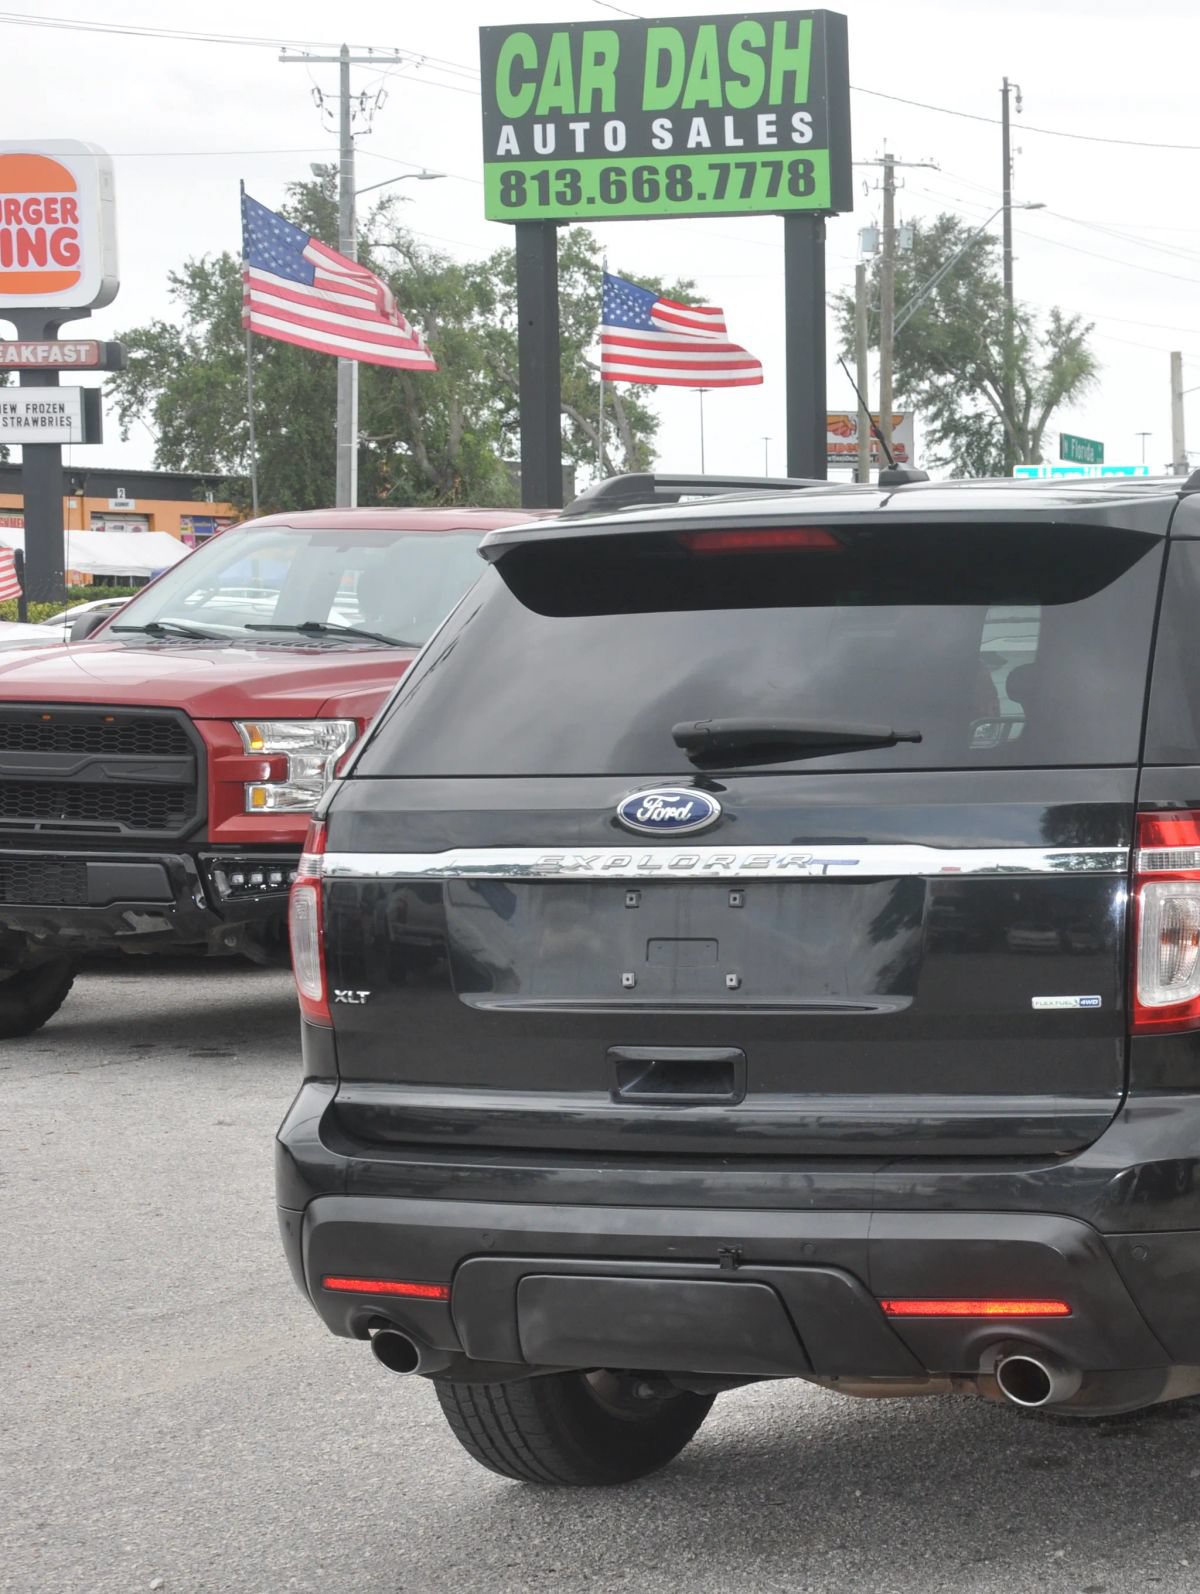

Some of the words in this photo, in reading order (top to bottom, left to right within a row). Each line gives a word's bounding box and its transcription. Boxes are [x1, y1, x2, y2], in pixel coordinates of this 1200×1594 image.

[496, 30, 620, 119] CAR
[642, 19, 813, 111] DASH
[496, 120, 626, 156] AUTO
[651, 111, 813, 150] SALES
[500, 159, 816, 208] 813.668.7778
[0, 196, 79, 226] RGER
[0, 226, 81, 268] ING
[2, 416, 72, 427] STRAWBRIES
[25, 403, 65, 414] FROZEN
[1071, 438, 1095, 463] Florida
[636, 794, 692, 822] Ford
[534, 853, 815, 873] EXPLORER
[334, 989, 370, 1004] XLT
[1080, 998, 1099, 1006] 4WD
